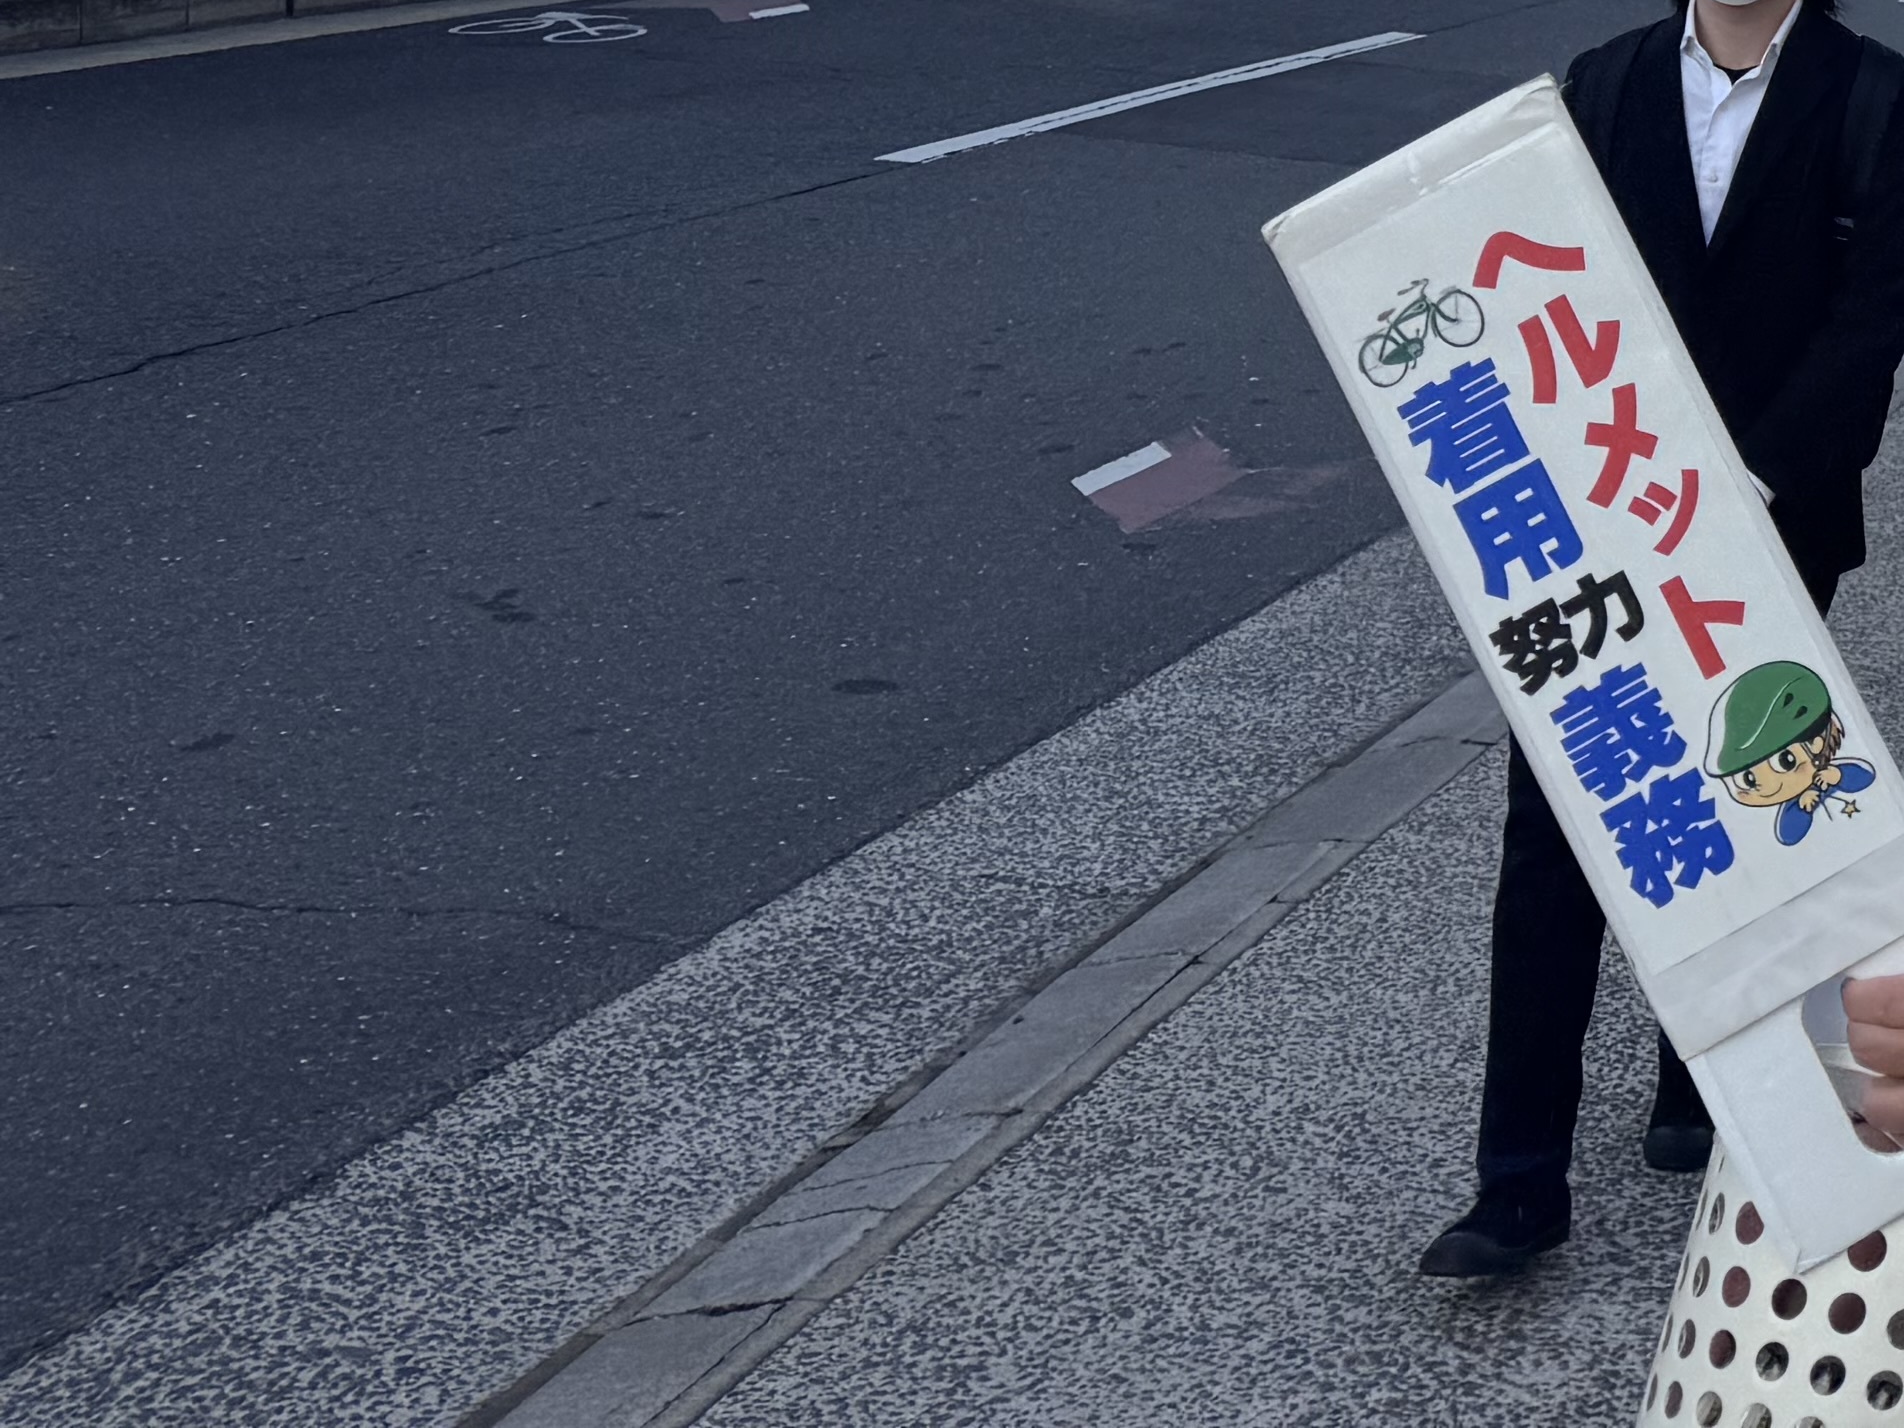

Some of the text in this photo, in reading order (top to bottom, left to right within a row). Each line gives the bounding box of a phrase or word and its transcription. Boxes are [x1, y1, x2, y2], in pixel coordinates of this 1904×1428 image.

[1471, 230, 1746, 680] ヘルメット
